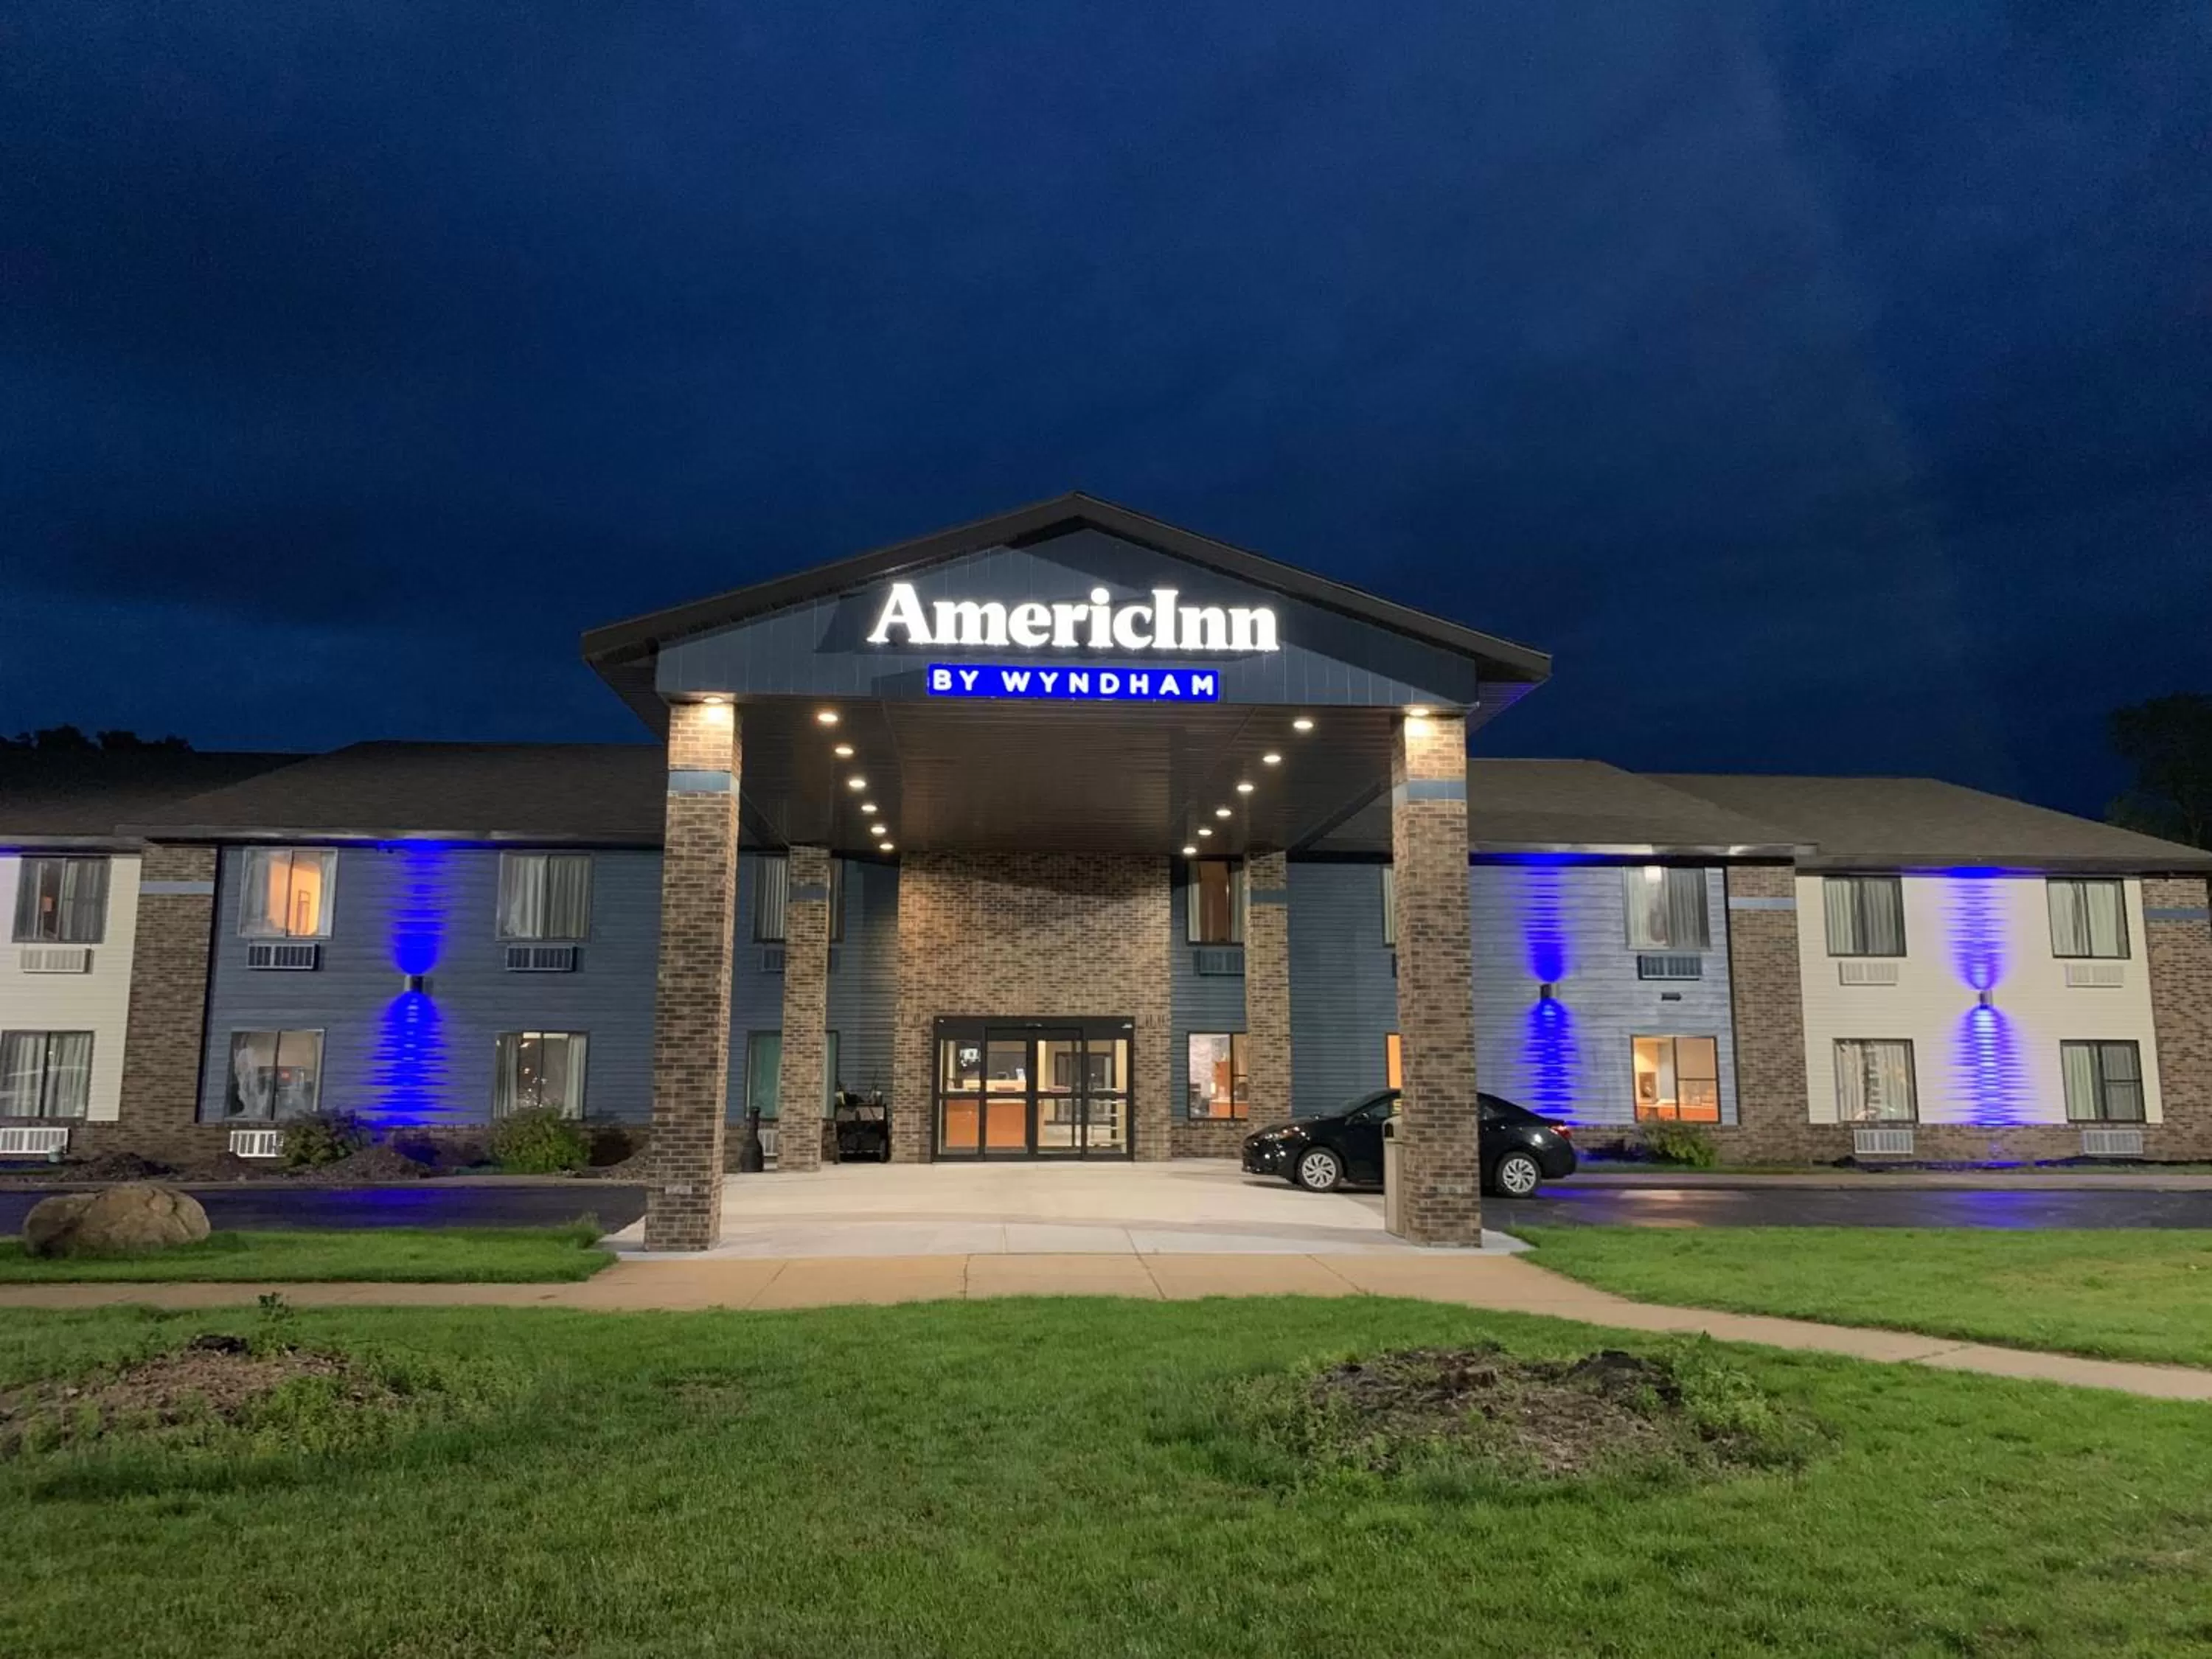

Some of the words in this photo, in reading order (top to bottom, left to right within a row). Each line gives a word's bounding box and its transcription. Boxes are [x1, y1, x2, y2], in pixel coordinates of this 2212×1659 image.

[866, 582, 1280, 652] AmericInn
[933, 669, 978, 691] BY
[1001, 671, 1214, 695] WYNDHAM
